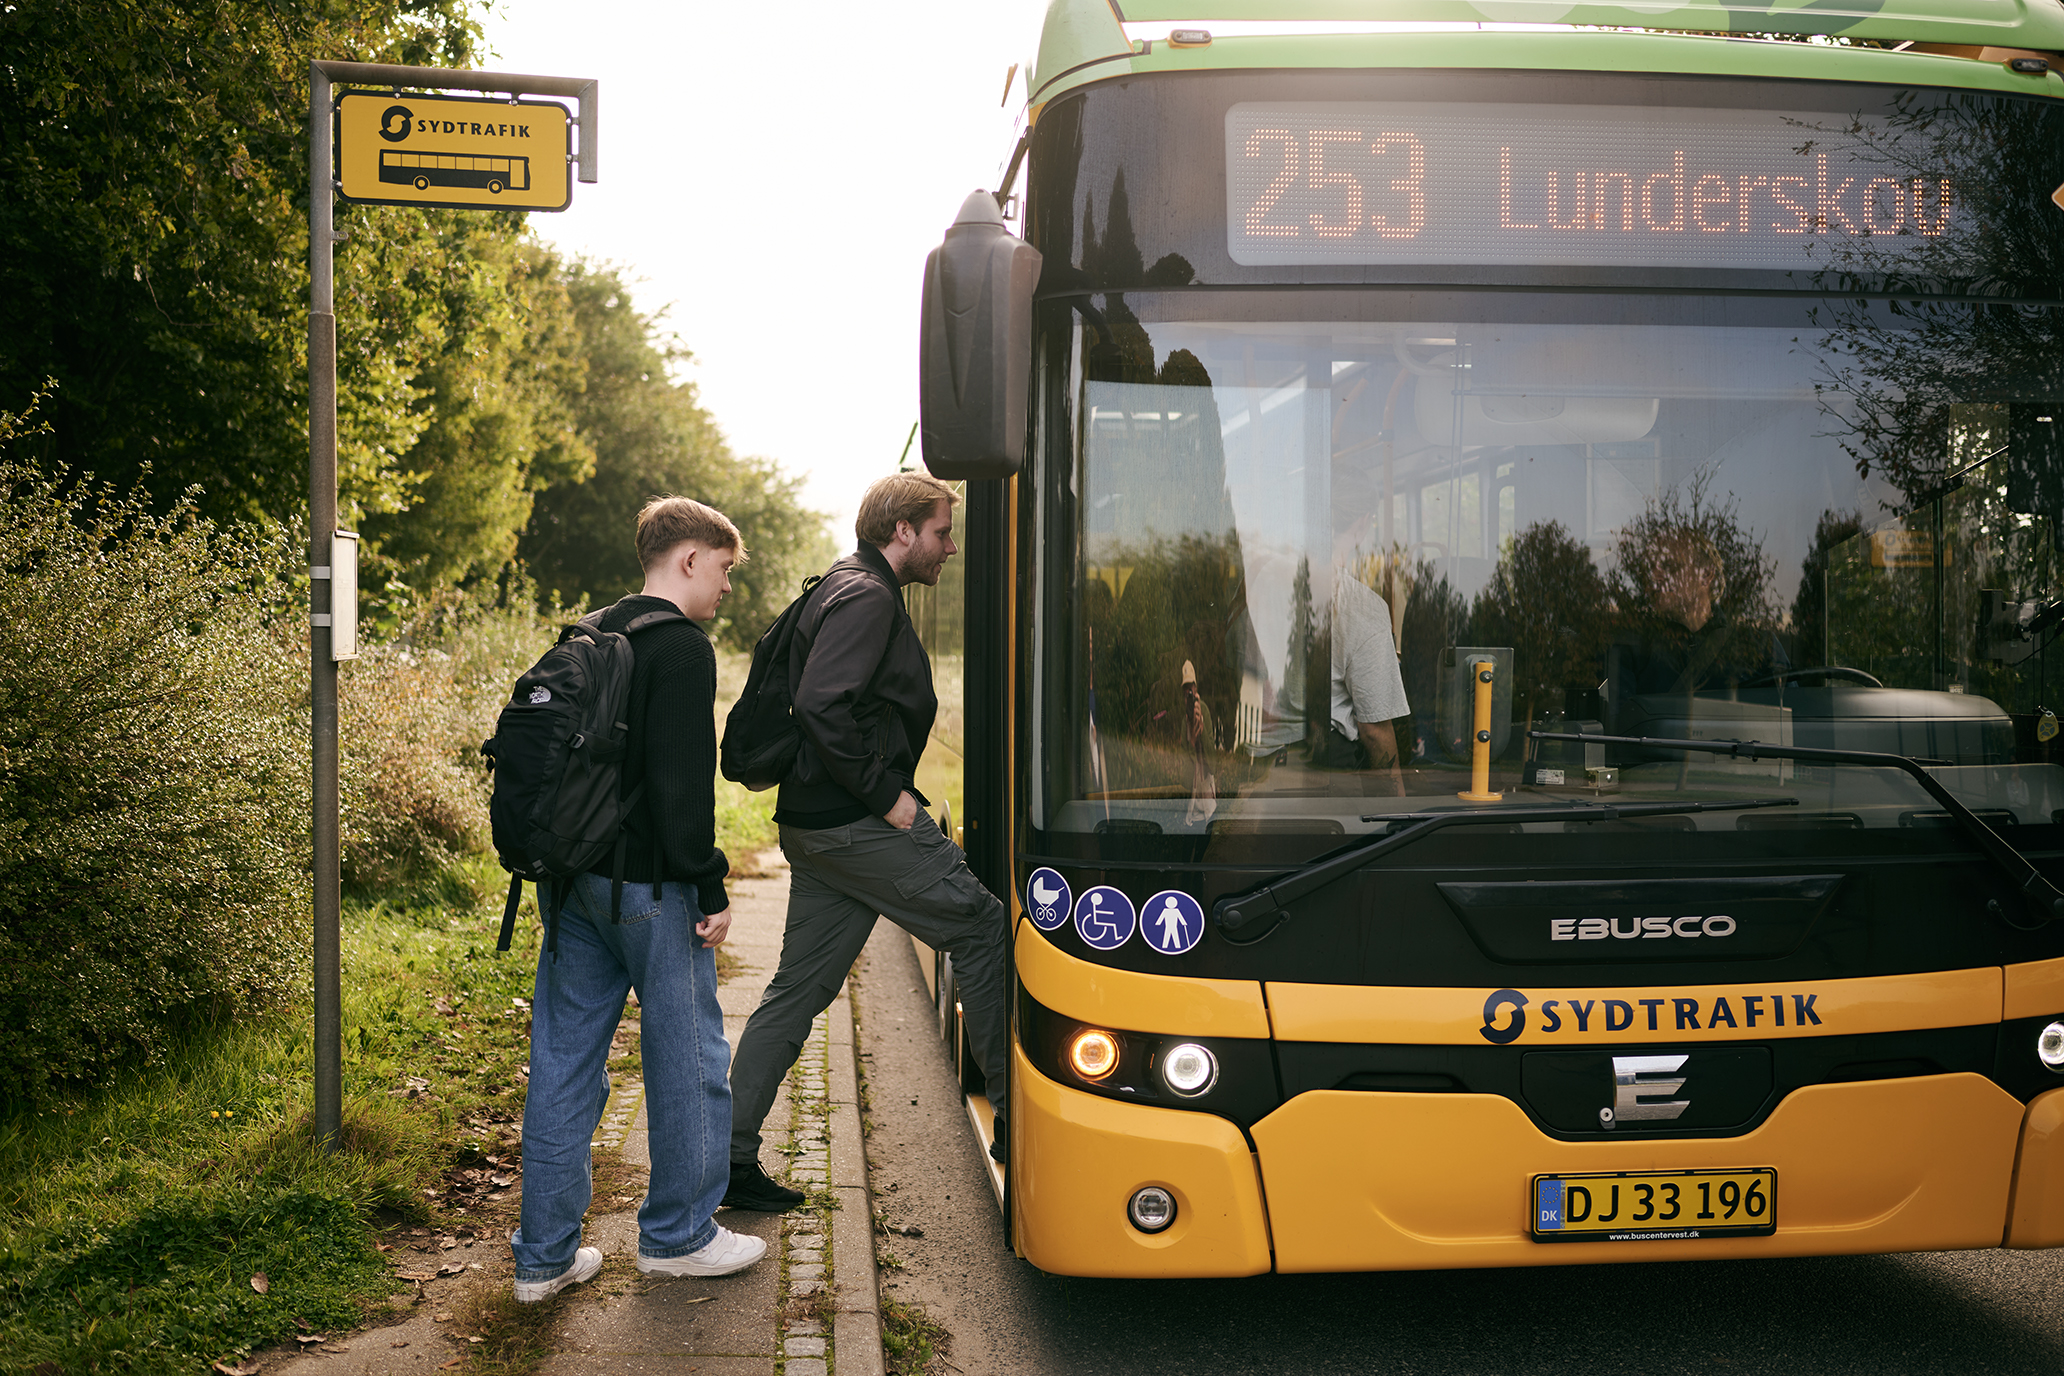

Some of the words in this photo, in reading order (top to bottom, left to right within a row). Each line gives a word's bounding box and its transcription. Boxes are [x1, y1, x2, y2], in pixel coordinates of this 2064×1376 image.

[417, 119, 531, 138] SYDTRAFIK
[1244, 128, 1425, 240] 253
[1500, 146, 1950, 237] Lunderskov
[1550, 915, 1737, 941] EBUSCO
[1540, 994, 1823, 1033] SYDTRAFIK
[1566, 1184, 1620, 1223] DJ
[1632, 1182, 1681, 1221] 33
[1697, 1178, 1767, 1220] 196
[1541, 1210, 1557, 1222] DK
[1609, 1230, 1700, 1241] www.buscentervest.dk
